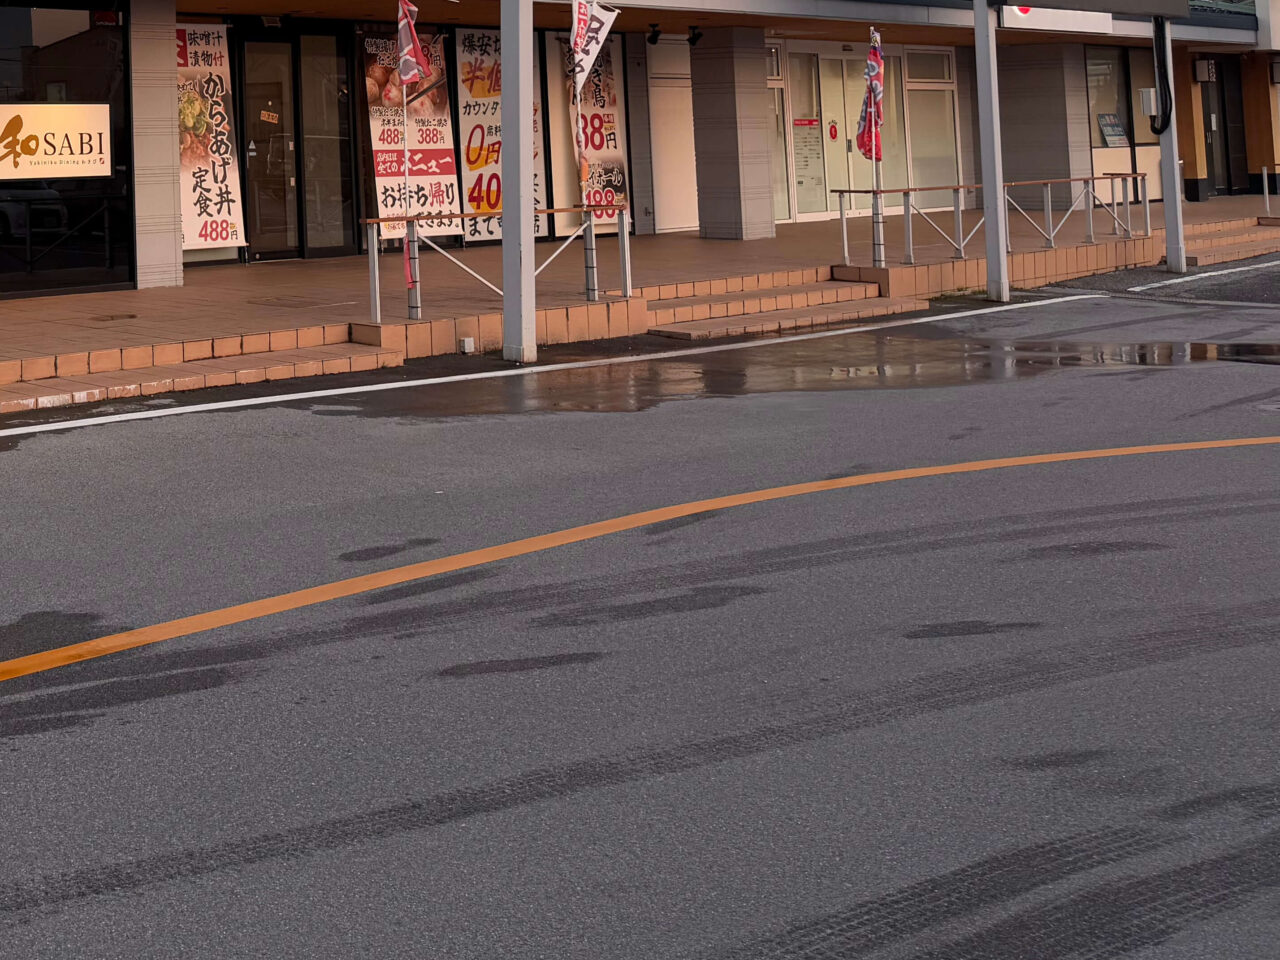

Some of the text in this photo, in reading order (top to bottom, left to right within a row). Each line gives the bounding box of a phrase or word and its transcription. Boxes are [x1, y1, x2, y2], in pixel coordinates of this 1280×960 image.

[187, 29, 224, 47] 味噌汁
[189, 50, 225, 68] 漬物付
[203, 71, 237, 217] からあげ丼
[192, 166, 214, 218] 定食
[380, 181, 455, 209] お持ち帰り
